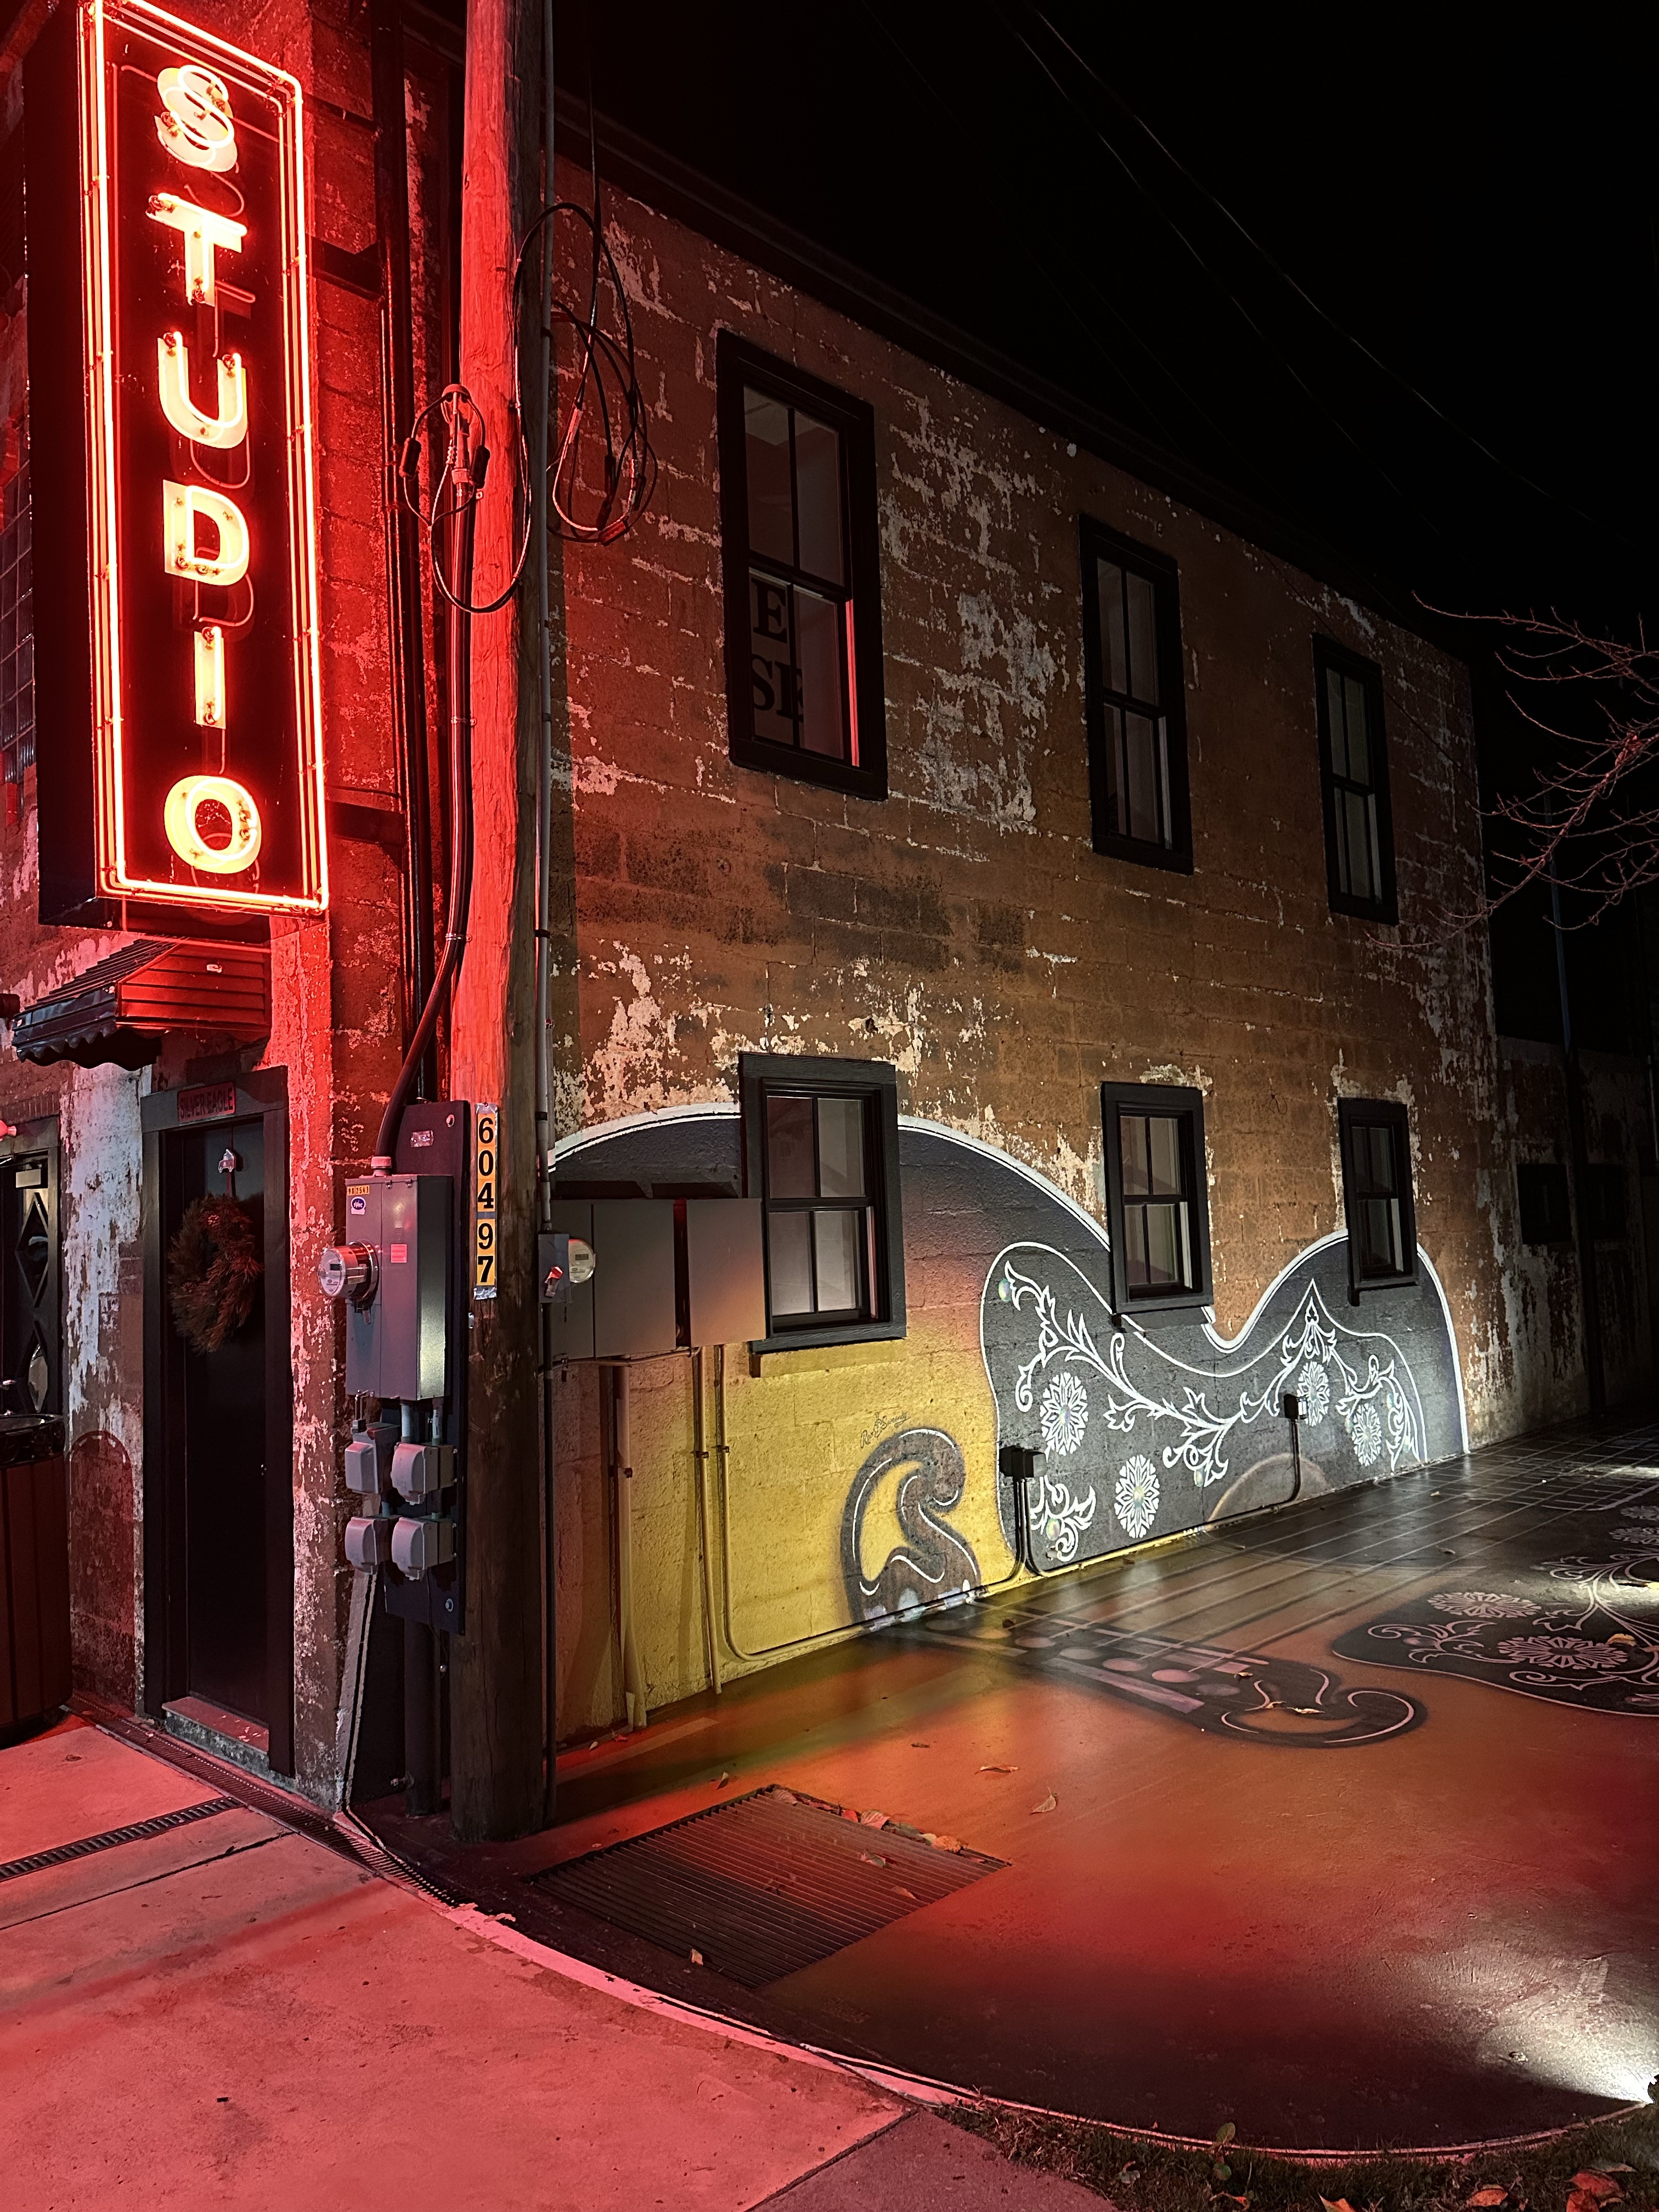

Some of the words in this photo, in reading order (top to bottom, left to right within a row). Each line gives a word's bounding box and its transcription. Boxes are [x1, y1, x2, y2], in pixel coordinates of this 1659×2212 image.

[146, 65, 261, 874] STUDIO
[179, 1093, 205, 1119] SILVER
[207, 1087, 233, 1113] EAGLE
